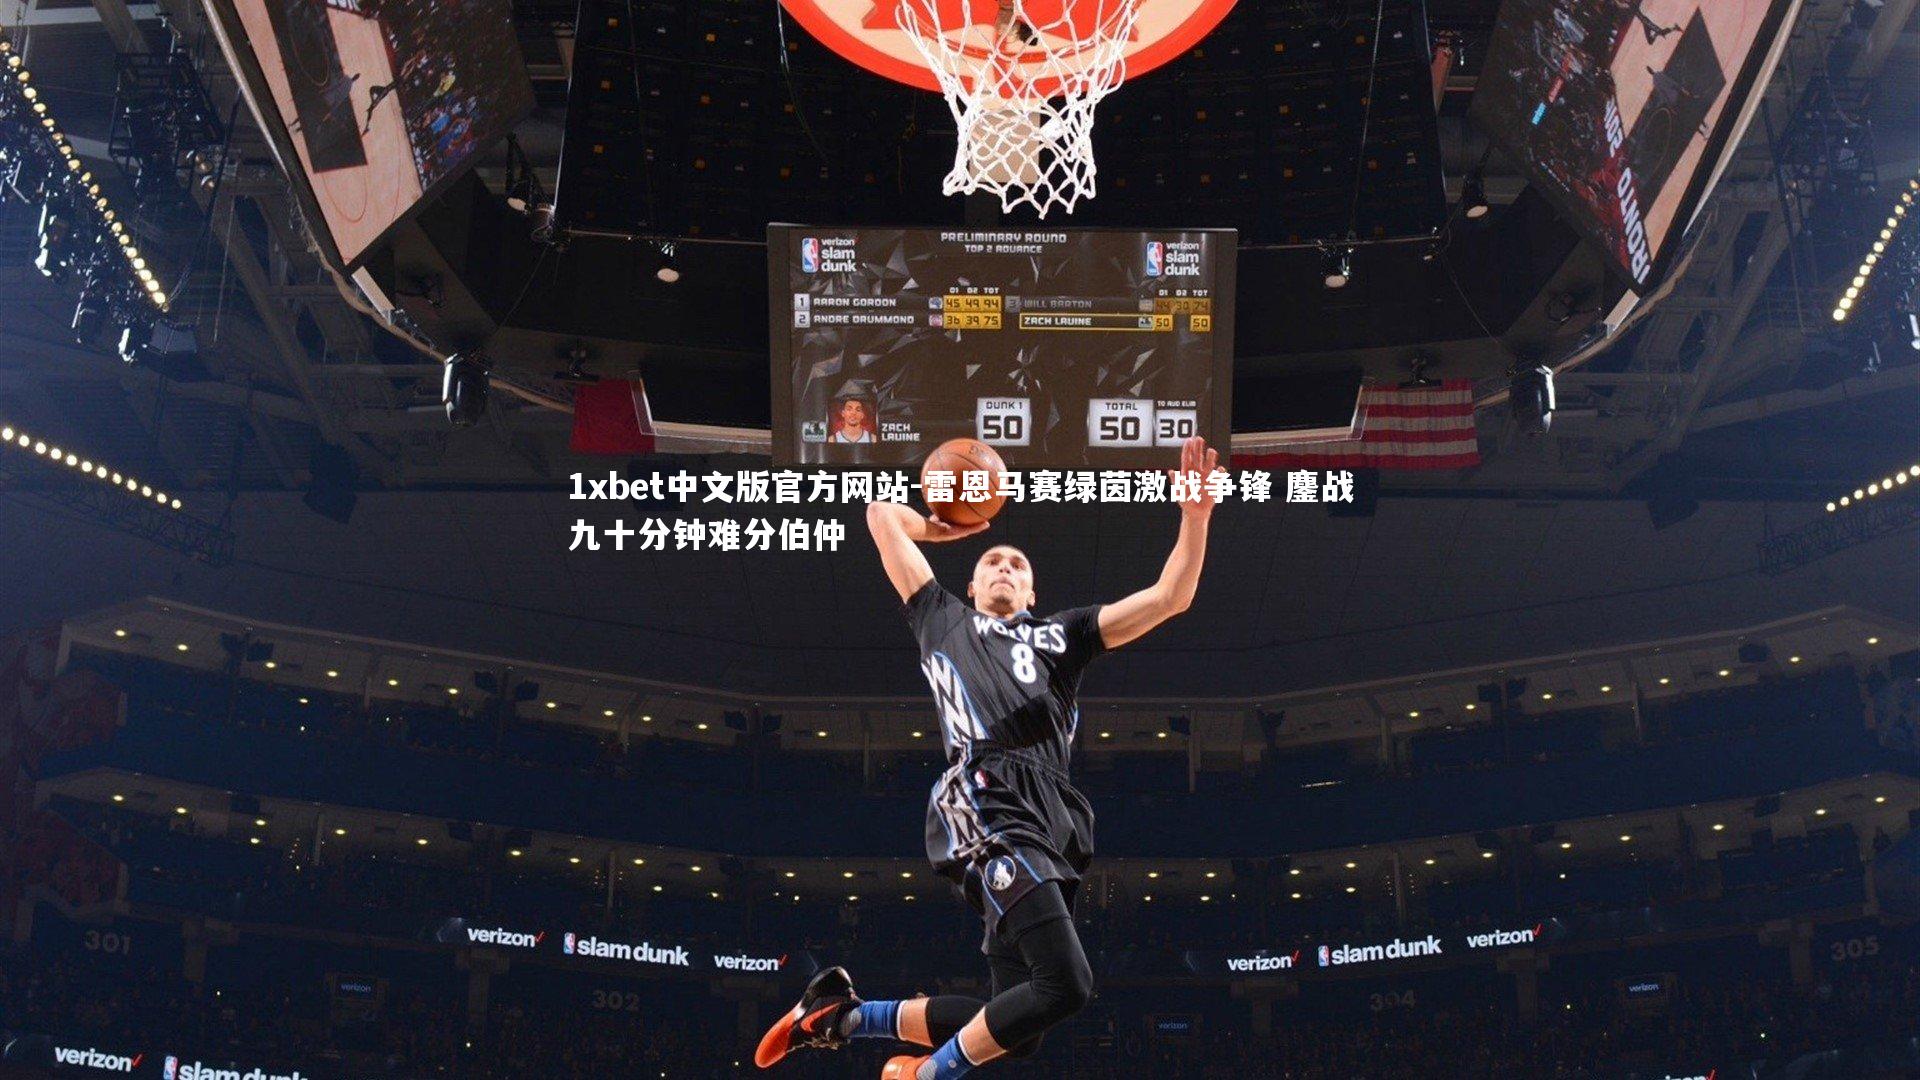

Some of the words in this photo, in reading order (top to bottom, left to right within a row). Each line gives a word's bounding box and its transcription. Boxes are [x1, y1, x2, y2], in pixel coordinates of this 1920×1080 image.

[821, 238, 855, 246] verizon
[941, 232, 1021, 242] PRELIMINARY
[1025, 233, 1067, 243] ROUND
[965, 244, 984, 253] TOP
[986, 245, 993, 253] 2
[1166, 242, 1199, 250] verizon
[821, 247, 855, 260] slam
[1165, 250, 1200, 263] slam
[821, 260, 856, 272] dunk
[1165, 263, 1200, 276] dunk
[813, 298, 850, 307] AARON
[853, 298, 897, 307] GORDON
[946, 299, 960, 308] 45
[965, 299, 980, 309] 49
[984, 299, 999, 309] 94
[1024, 300, 1048, 308] WILL
[1050, 300, 1092, 309] BARTON
[799, 314, 807, 324] 2
[813, 315, 849, 324] ANDRE
[852, 315, 914, 324] DRUMMOND
[965, 315, 980, 326] 39
[984, 315, 999, 326] 75
[1024, 317, 1052, 326] ZACH
[1156, 318, 1170, 328] 50
[1193, 318, 1208, 328] 50
[986, 401, 1015, 410] DUNK
[1018, 401, 1023, 410] 1
[1106, 402, 1138, 411] TOTAL
[881, 423, 911, 432] ZACH
[983, 415, 1023, 440] 50
[1100, 416, 1140, 441] 50
[1159, 418, 1193, 439] 30
[881, 432, 920, 442] LAVINE
[1011, 643, 1036, 684] 8
[84, 930, 131, 955] 301
[467, 927, 536, 947] verizon
[1466, 927, 1535, 949] verizon
[577, 936, 631, 960] slam
[632, 942, 690, 966] dunk
[1330, 944, 1384, 966] slam
[1385, 934, 1443, 960] dunk
[1830, 935, 1880, 961] 305
[714, 953, 780, 972] verizon
[1226, 949, 1293, 972] verizon
[340, 982, 373, 994] verizon
[1628, 982, 1660, 993] verizon
[592, 989, 641, 1012] 302
[1157, 1020, 1189, 1031] verizon
[54, 1046, 133, 1072] verizon
